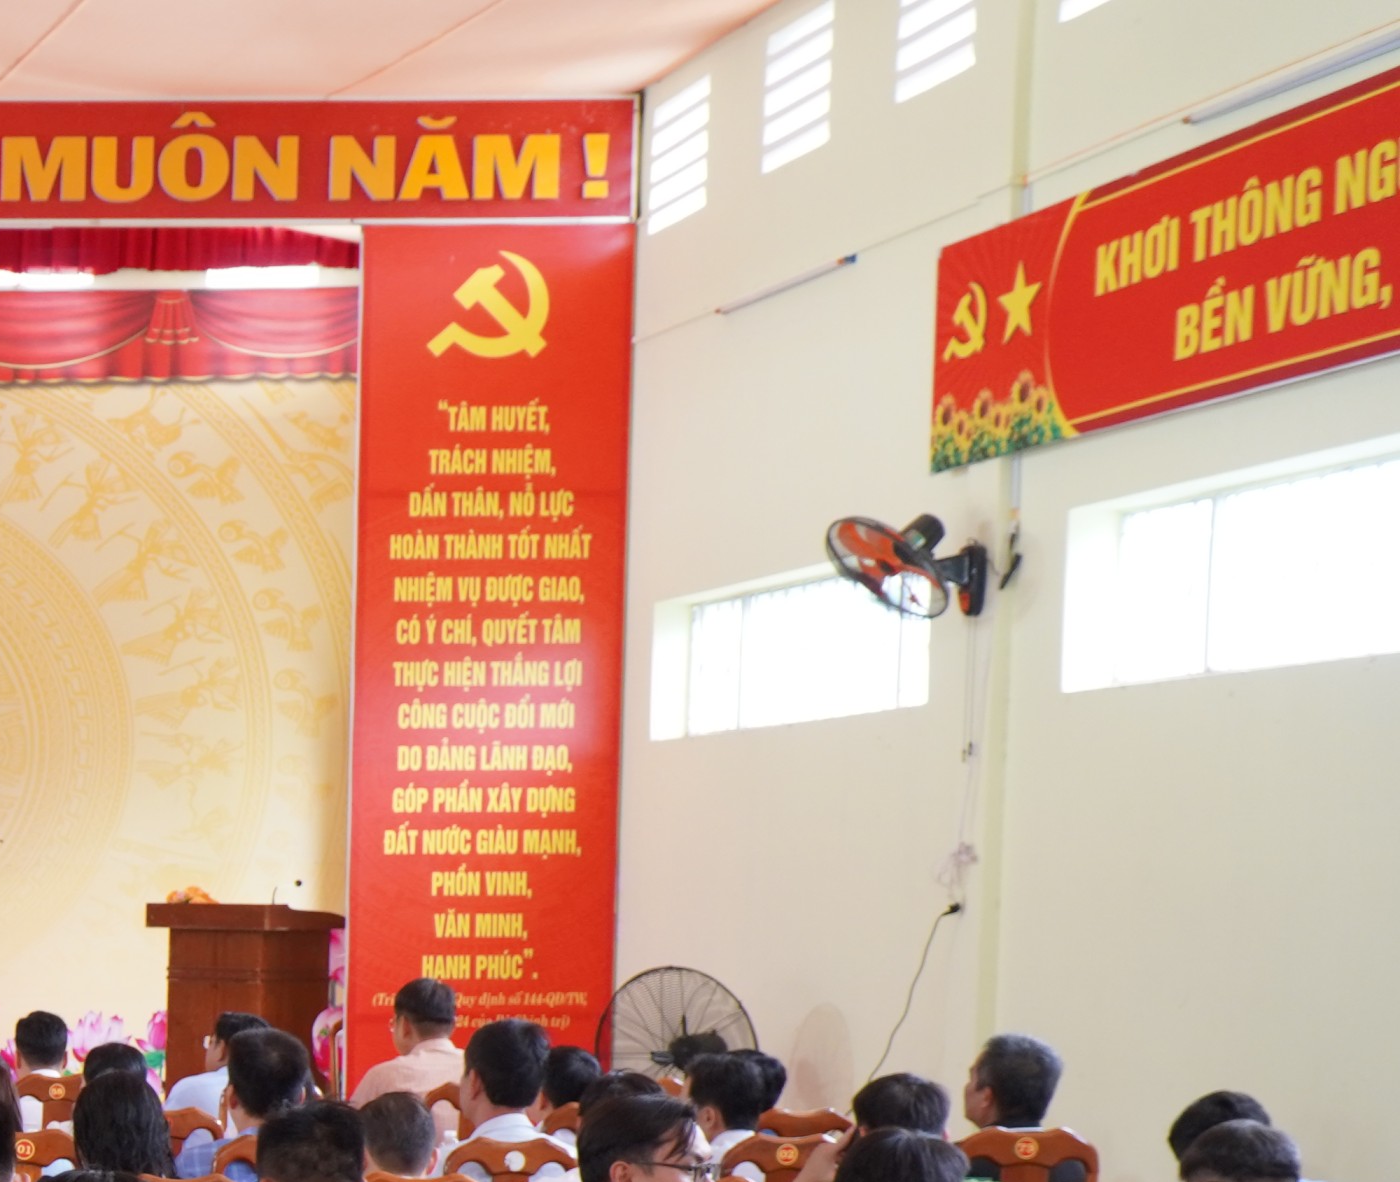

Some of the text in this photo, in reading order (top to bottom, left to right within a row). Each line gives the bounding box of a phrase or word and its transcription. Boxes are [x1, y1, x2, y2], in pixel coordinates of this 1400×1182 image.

[3, 110, 302, 203] MUÔN
[329, 115, 561, 203] NĂM
[584, 132, 611, 200] !
[1094, 138, 1400, 297] KHƠI THÔNG NG
[1174, 246, 1395, 362] BỀN VỮNG,
[491, 399, 550, 433] HUYẾT,
[429, 444, 556, 478] TRÁCH NHIỆM,
[452, 486, 504, 520] THÂN,
[540, 489, 574, 522] LỰC
[390, 526, 592, 560] HOÀN THÀNH TỐT NHẤT
[394, 572, 584, 607] NHIỆM VỤ ĐƯỢC GIAO,
[396, 612, 581, 647] CÓ Ý CHÍ, QUYẾT TÂM
[392, 653, 582, 692] THỰC HIỆN THẮNG LỢI
[398, 698, 447, 729] CÔNG
[451, 699, 500, 733] CUỘC
[540, 699, 574, 728] MỚI
[398, 738, 572, 775] DO ĐẢNG LÃNH ĐẠO,
[392, 783, 428, 813] GÓP
[487, 782, 522, 812] XÂY
[526, 785, 576, 817] DỰNG
[384, 821, 581, 859] ĐẤT NƯỚC GIÀU MẠNH,
[485, 872, 532, 898] VINH,
[434, 909, 527, 939] VĂN MINH,
[422, 955, 470, 983] HẠNH
